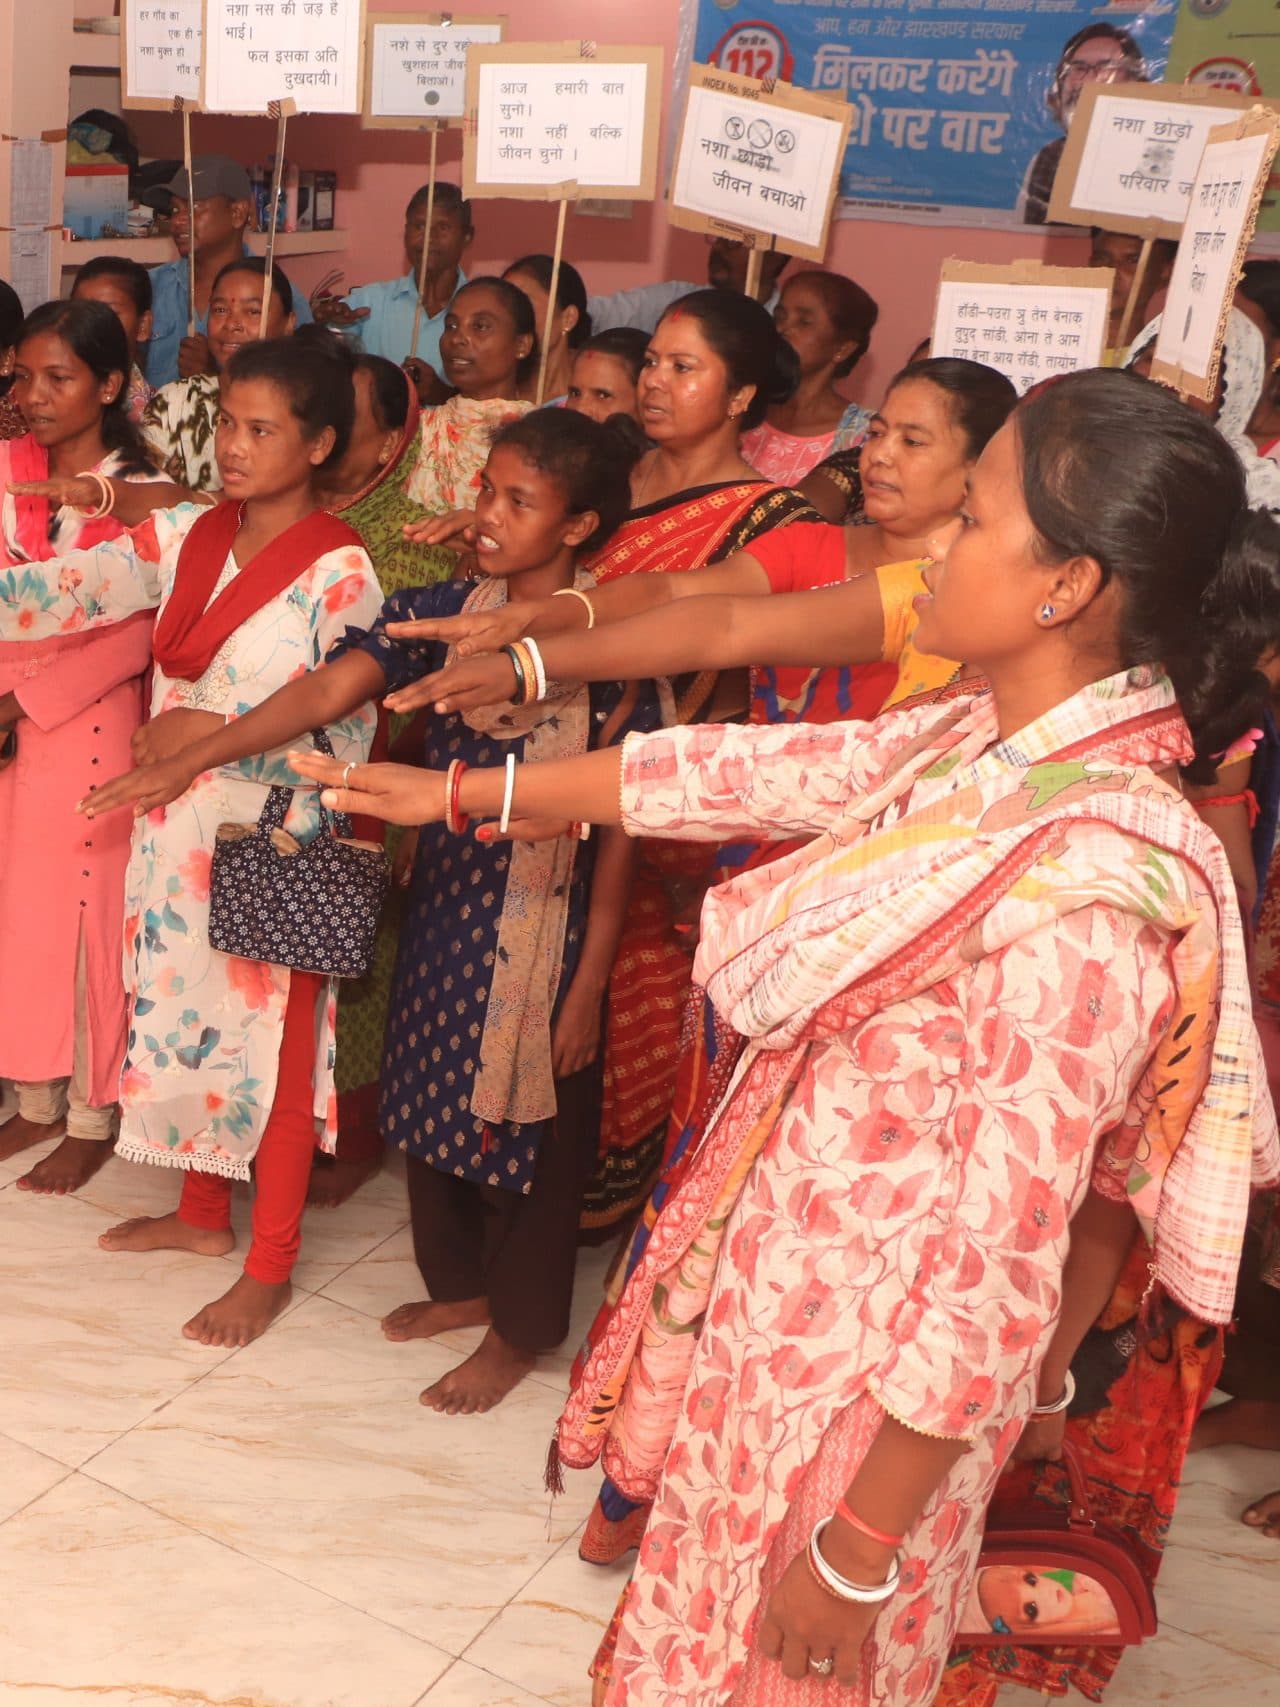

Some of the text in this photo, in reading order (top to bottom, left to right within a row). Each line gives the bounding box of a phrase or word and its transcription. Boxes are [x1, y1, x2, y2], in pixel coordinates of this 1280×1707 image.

[226, 4, 249, 16] नशा
[255, 4, 274, 16] नस
[280, 0, 296, 15] की
[185, 27, 193, 39] ही
[140, 46, 154, 56] नशा
[158, 46, 172, 59] मुक्त
[390, 37, 409, 51] नशे
[415, 37, 426, 51] से
[247, 46, 338, 64] फल इसका अति
[401, 60, 439, 72] खुशहाल
[726, 48, 774, 80] 112
[812, 44, 1019, 96] मिलकर करेंगे
[500, 79, 624, 95] आज हमारी बात
[498, 123, 623, 139] नशा नहीं बल्कि
[881, 107, 936, 150] पर
[940, 110, 1011, 154] वार
[1113, 117, 1145, 134] नशा
[498, 144, 532, 160] जीवन
[539, 145, 563, 164] चुनो
[701, 138, 730, 159] नशा
[712, 169, 807, 212] जीवन बचाओ
[1120, 171, 1170, 193] परिवार
[1058, 334, 1080, 347] आम
